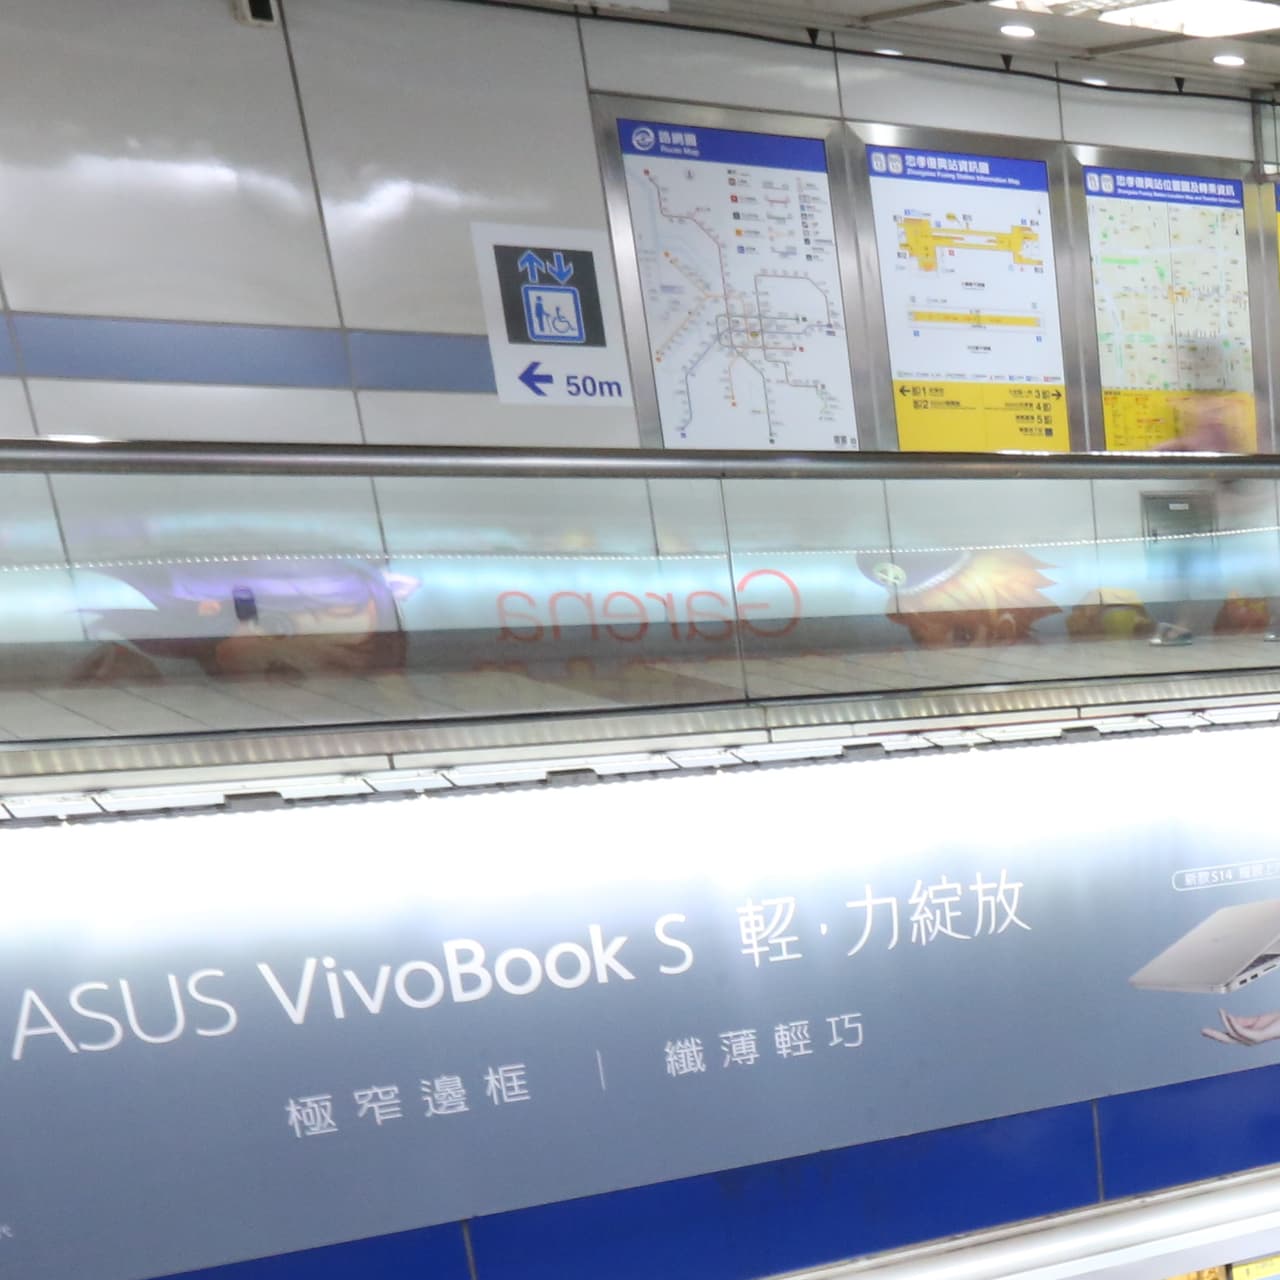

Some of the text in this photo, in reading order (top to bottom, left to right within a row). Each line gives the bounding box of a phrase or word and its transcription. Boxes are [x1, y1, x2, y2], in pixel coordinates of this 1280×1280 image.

[565, 374, 624, 398] 50m
[11, 968, 239, 1061] ASUS
[257, 922, 637, 1027] VivoBook
[652, 912, 694, 976] S
[283, 1012, 865, 1139] 極窄邊框 纖薄輕巧
